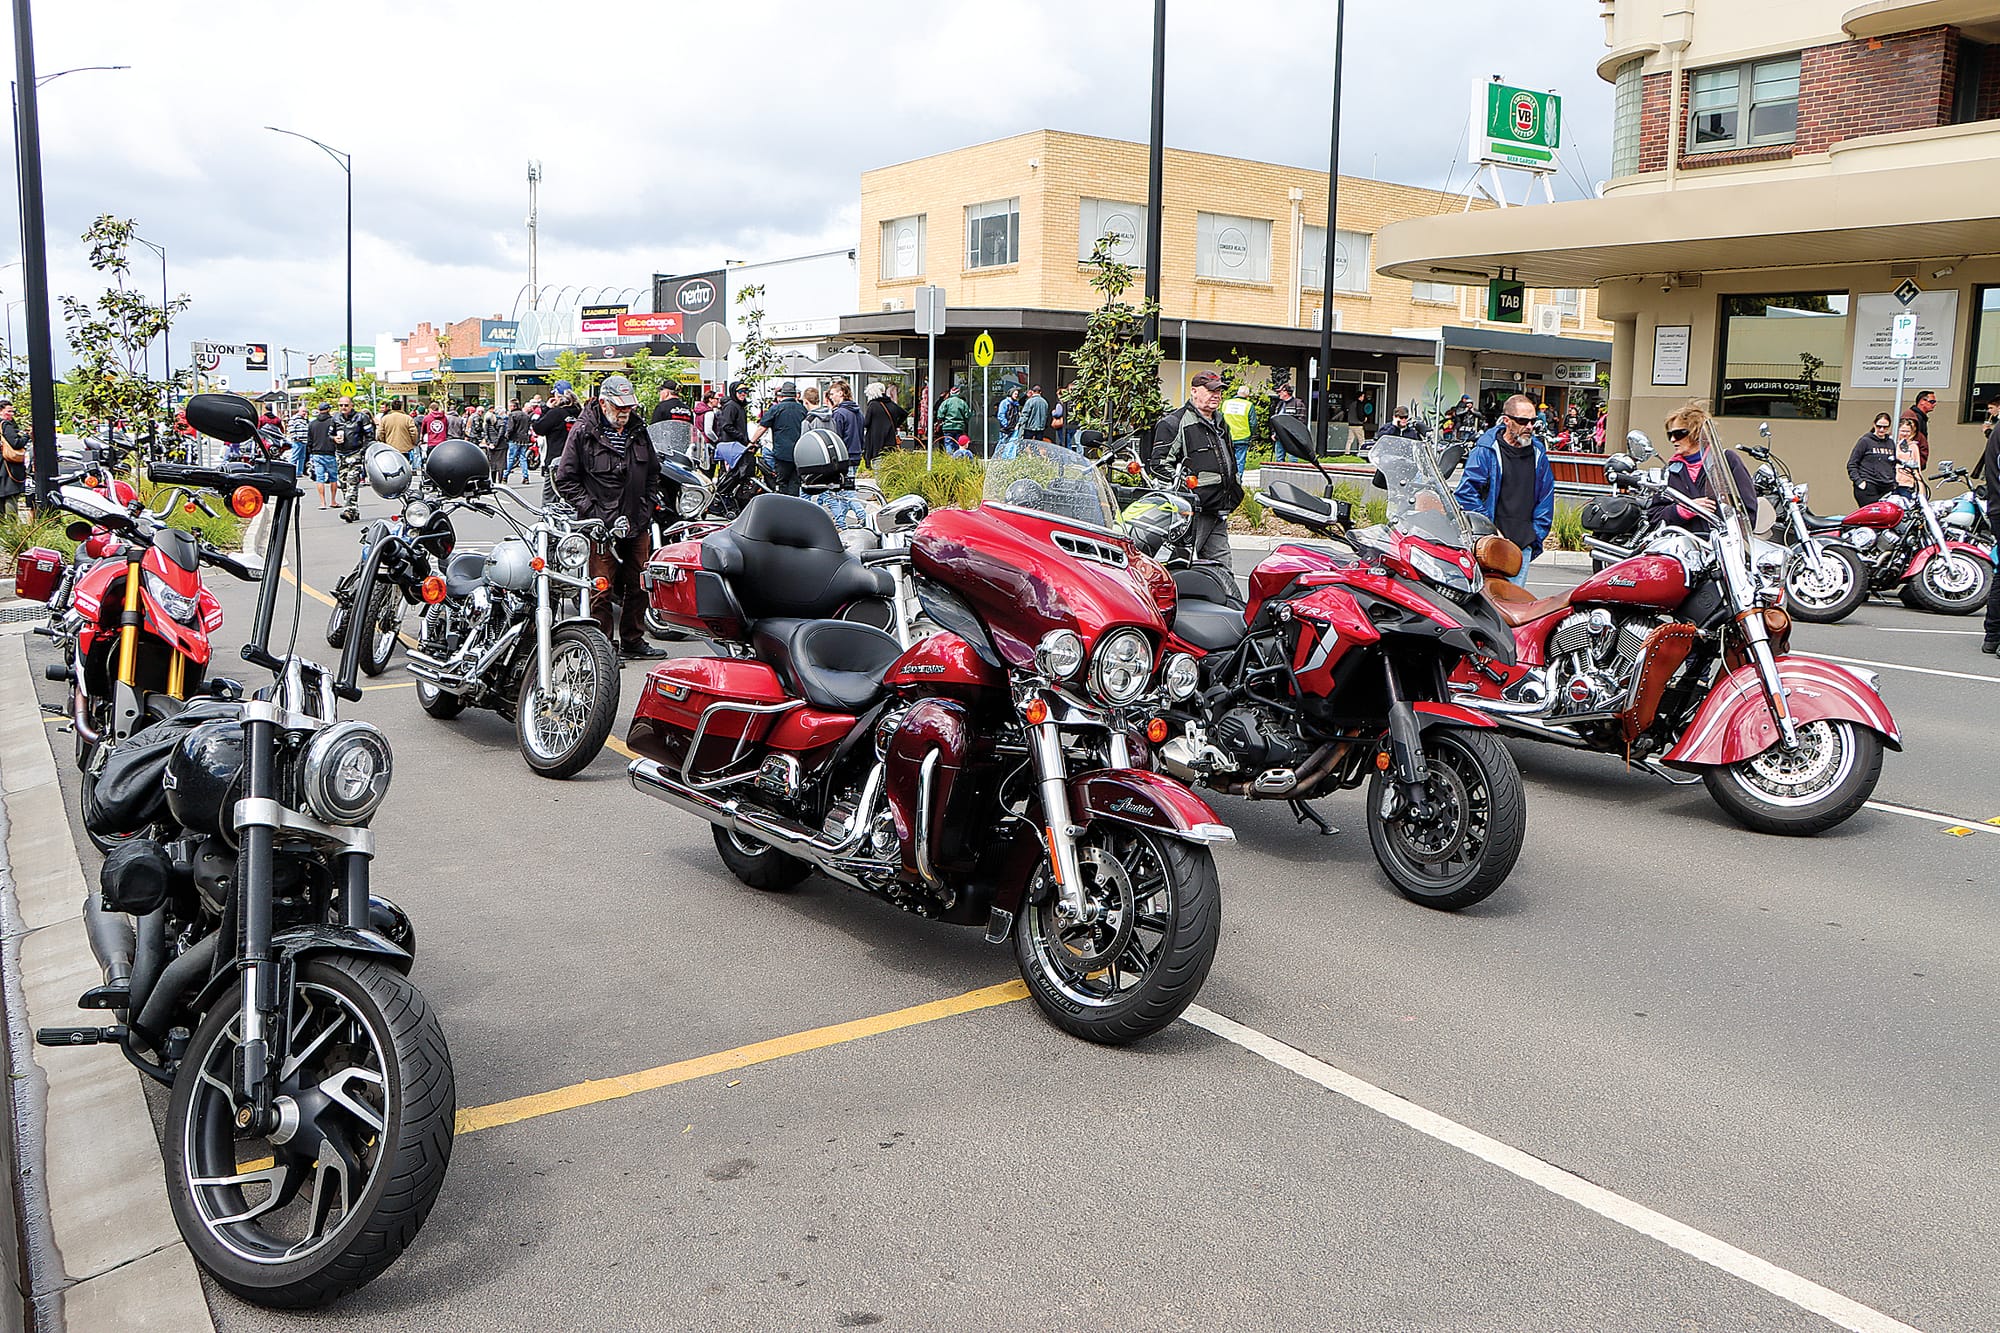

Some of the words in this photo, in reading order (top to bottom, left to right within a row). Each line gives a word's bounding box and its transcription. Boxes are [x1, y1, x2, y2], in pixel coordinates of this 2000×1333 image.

[1518, 109, 1532, 123] VB
[681, 284, 712, 305] nextra
[1500, 294, 1520, 308] TAB
[1898, 319, 1912, 329] 1P
[487, 327, 517, 340] ANZ
[205, 343, 235, 355] LYON
[1039, 979, 1082, 1013] MICHELIN
